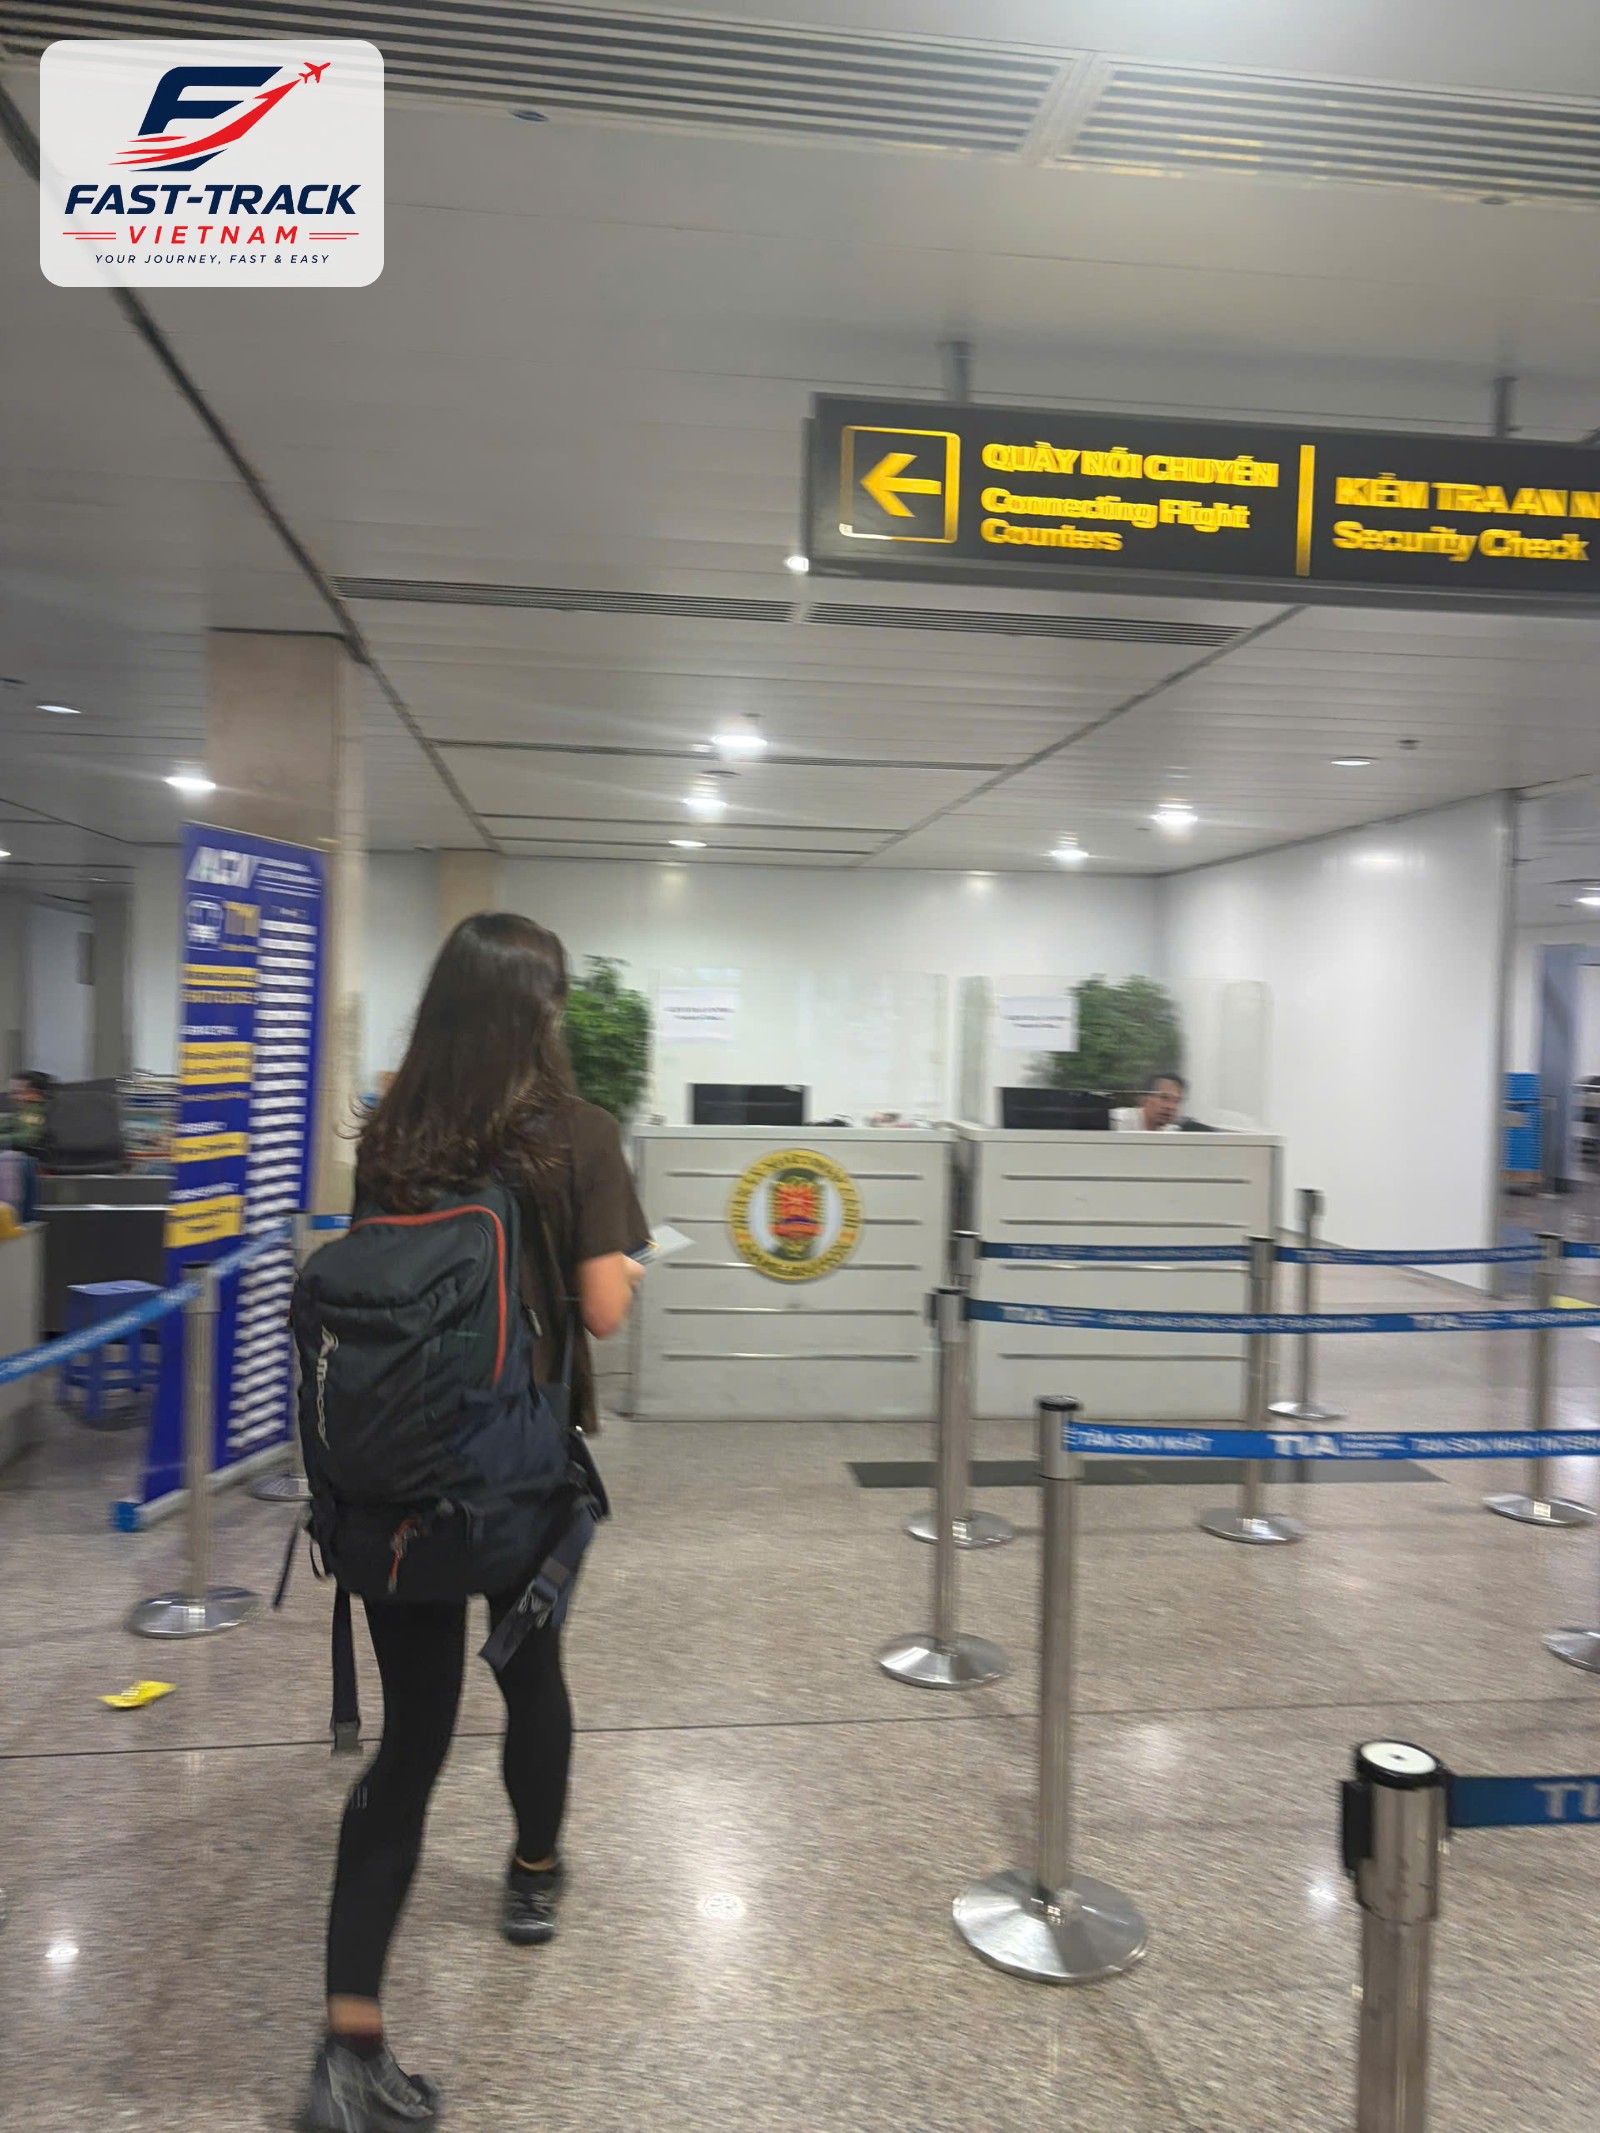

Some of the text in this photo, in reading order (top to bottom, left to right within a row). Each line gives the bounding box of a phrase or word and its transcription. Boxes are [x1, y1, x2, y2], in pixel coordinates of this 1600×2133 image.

[980, 487, 1251, 533] Connecting Flight
[1431, 482, 1510, 514] TRA
[980, 518, 1123, 551] Counters
[1332, 520, 1591, 562] Security Check
[1534, 1781, 1600, 1820] TI
